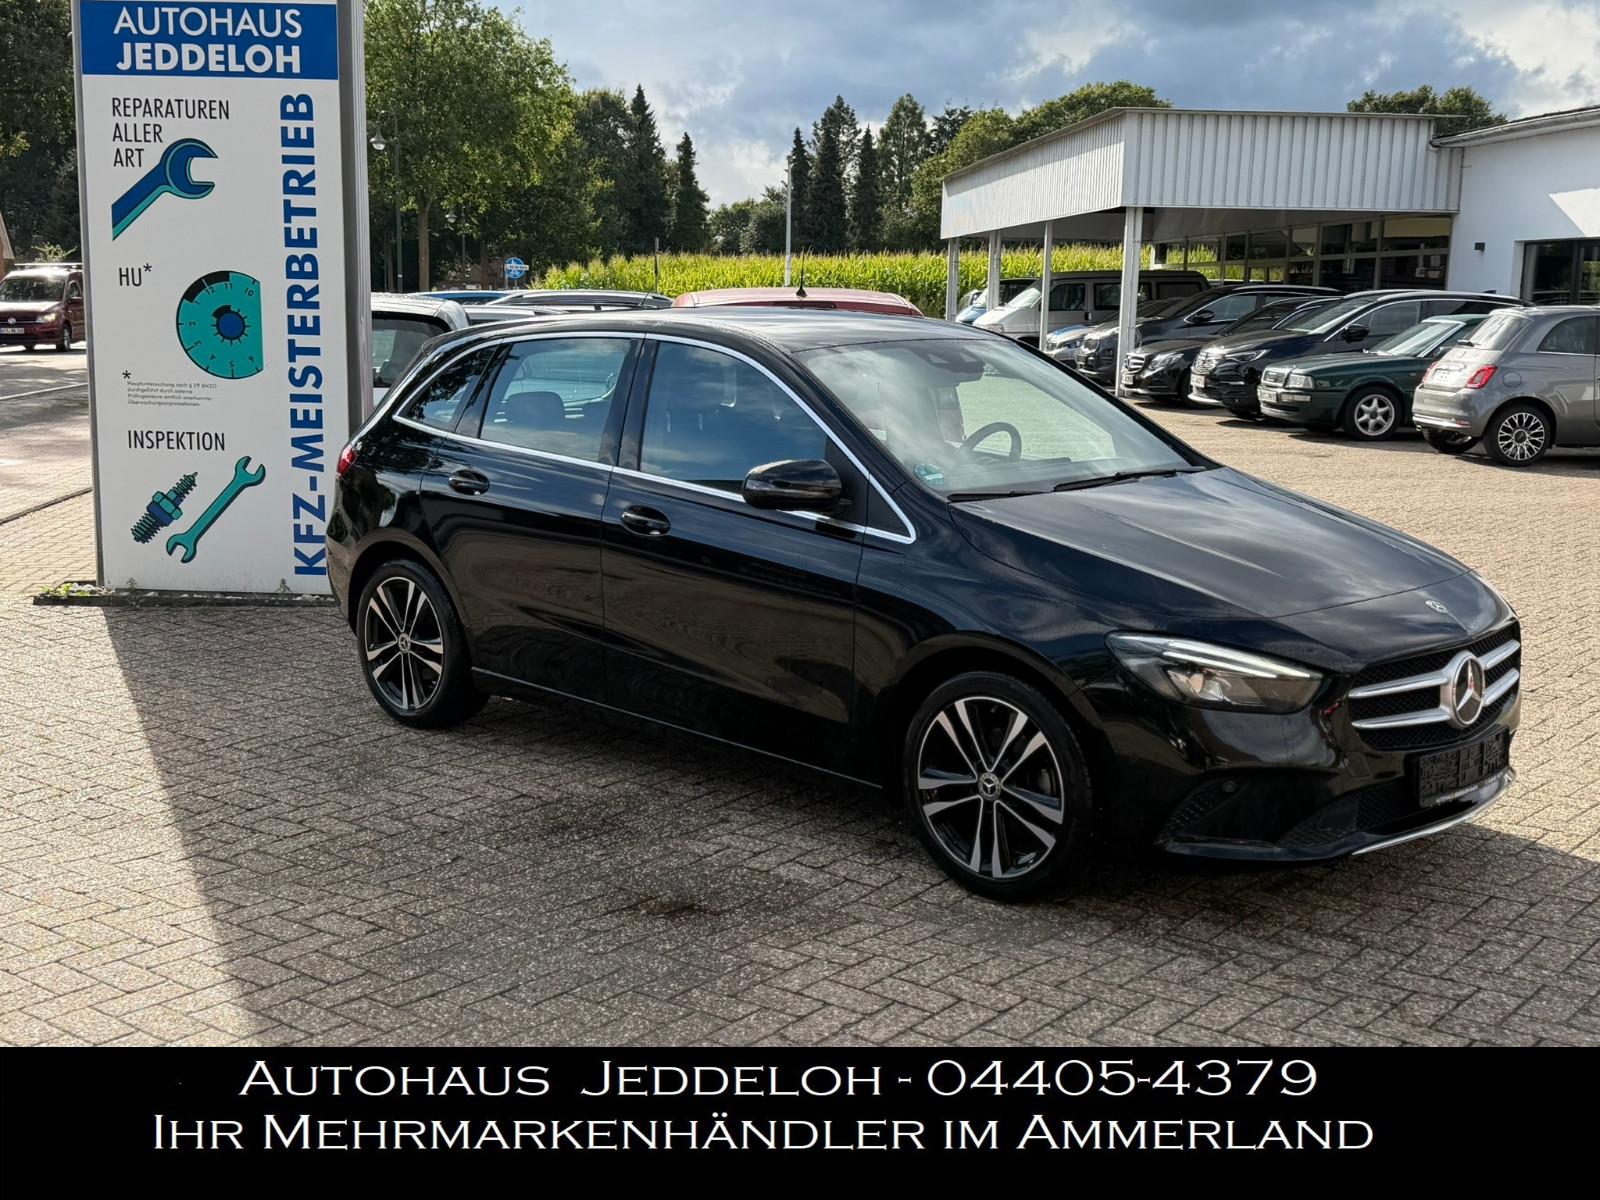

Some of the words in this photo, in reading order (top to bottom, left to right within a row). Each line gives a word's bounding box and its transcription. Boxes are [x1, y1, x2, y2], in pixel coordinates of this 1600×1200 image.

[113, 6, 302, 38] AUTOHAUS
[116, 42, 300, 73] JEDDELOH
[112, 97, 230, 119] REPARATUREN
[112, 123, 163, 144] ALLER
[113, 148, 144, 168] ART
[205, 286, 215, 295] 12
[244, 287, 254, 297] 10
[280, 93, 328, 576] KFZ-MEISTERBETRIEB
[128, 430, 226, 452] INSPEKTION
